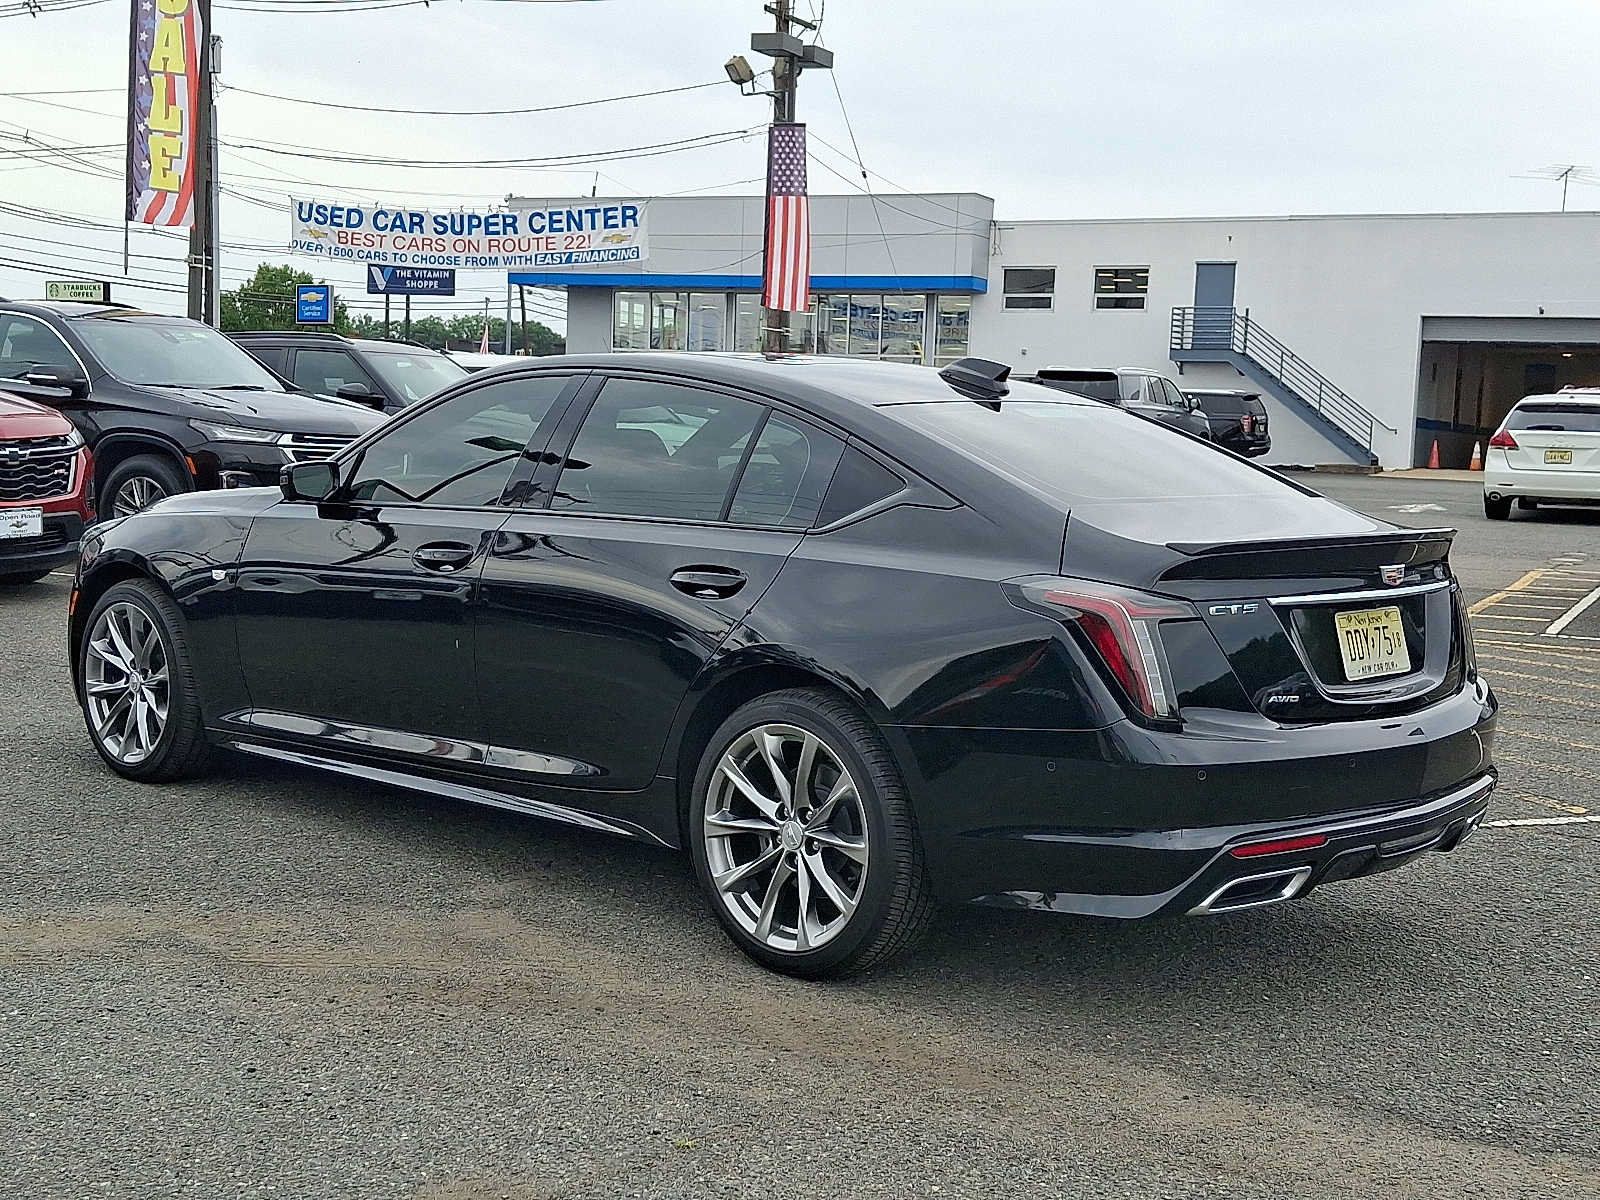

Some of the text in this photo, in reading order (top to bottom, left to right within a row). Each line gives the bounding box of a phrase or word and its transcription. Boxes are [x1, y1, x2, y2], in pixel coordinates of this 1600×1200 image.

[149, 0, 187, 192] ALE
[298, 201, 639, 236] USED CAR SUPER CENTER
[337, 230, 592, 253] BEST CARS ON ROUTE 22!
[291, 239, 638, 267] OVER 1500 CARS TO CHOOSE FROM WITH EASY FINANCING
[396, 269, 450, 279] THE VITAMIN
[405, 279, 439, 289] SHOPPE
[1208, 603, 1260, 616] CT5
[1268, 695, 1300, 704] AWD
